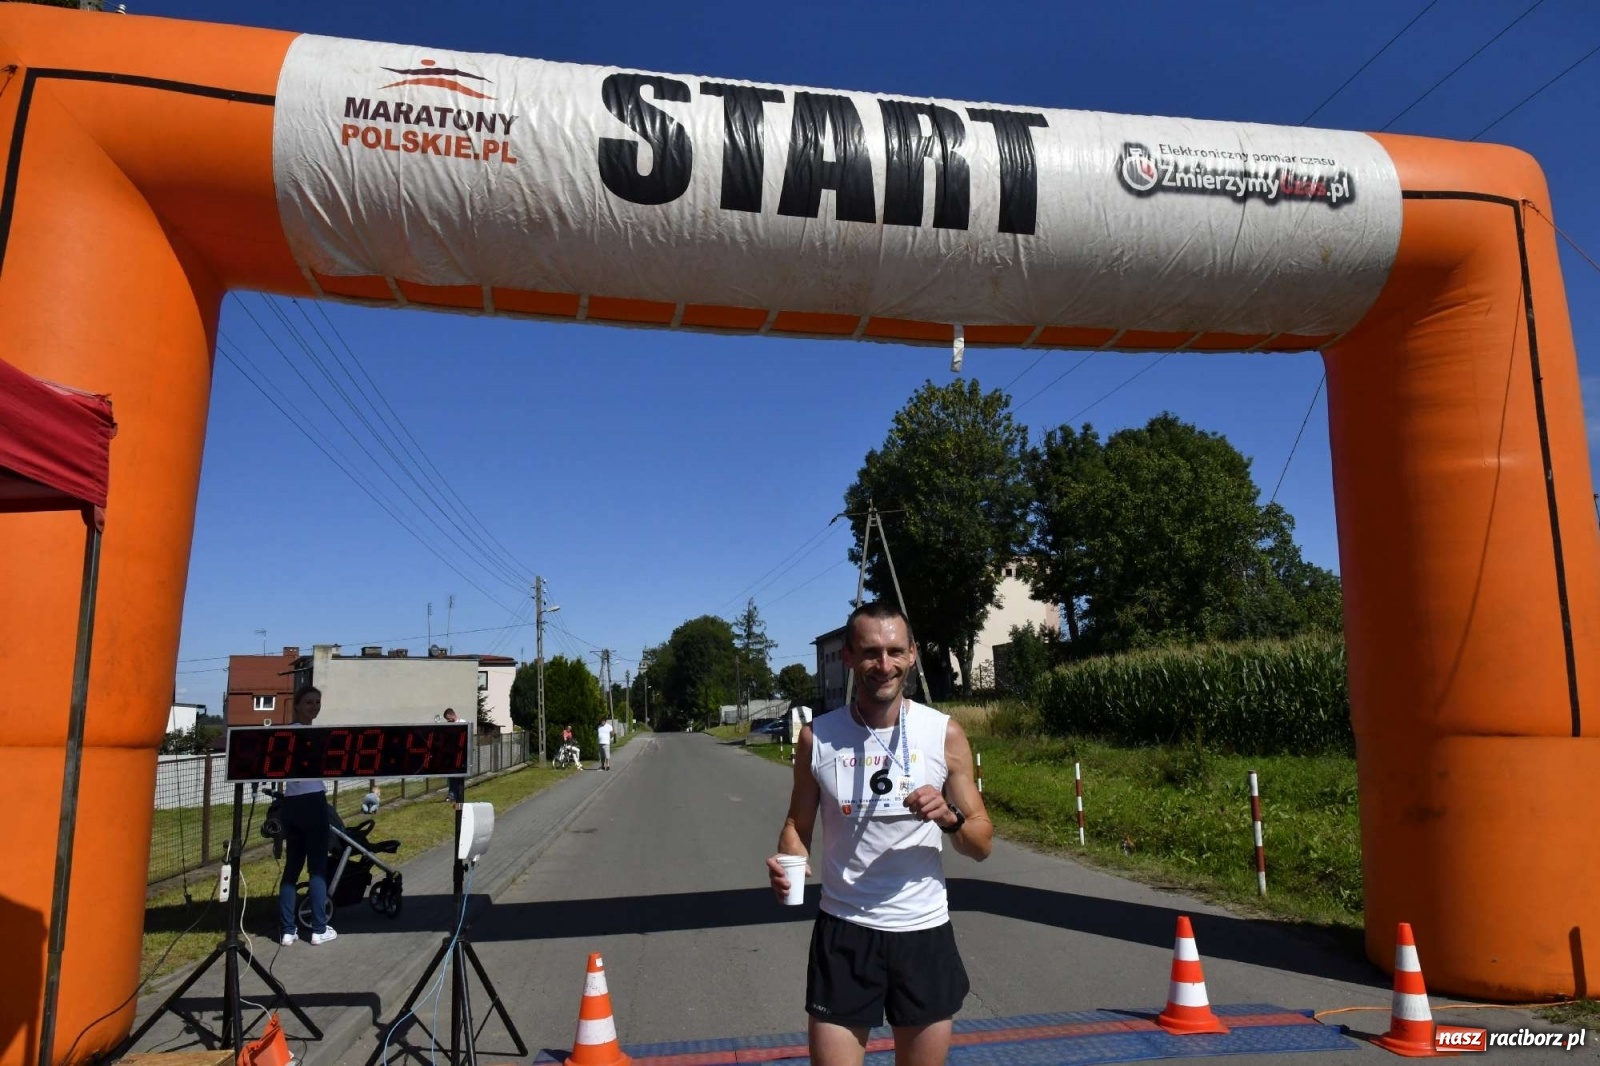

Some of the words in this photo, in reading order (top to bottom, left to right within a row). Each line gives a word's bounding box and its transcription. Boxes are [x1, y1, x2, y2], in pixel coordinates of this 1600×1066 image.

[344, 96, 519, 136] MARATONY
[341, 123, 518, 165] POLSKIE.PL
[598, 73, 1049, 236] START
[1158, 143, 1249, 163] Elektroniczny
[1253, 152, 1297, 166] pomiar
[1299, 156, 1337, 167] czasu
[263, 730, 466, 776] 0:38:41
[869, 769, 893, 795] 6
